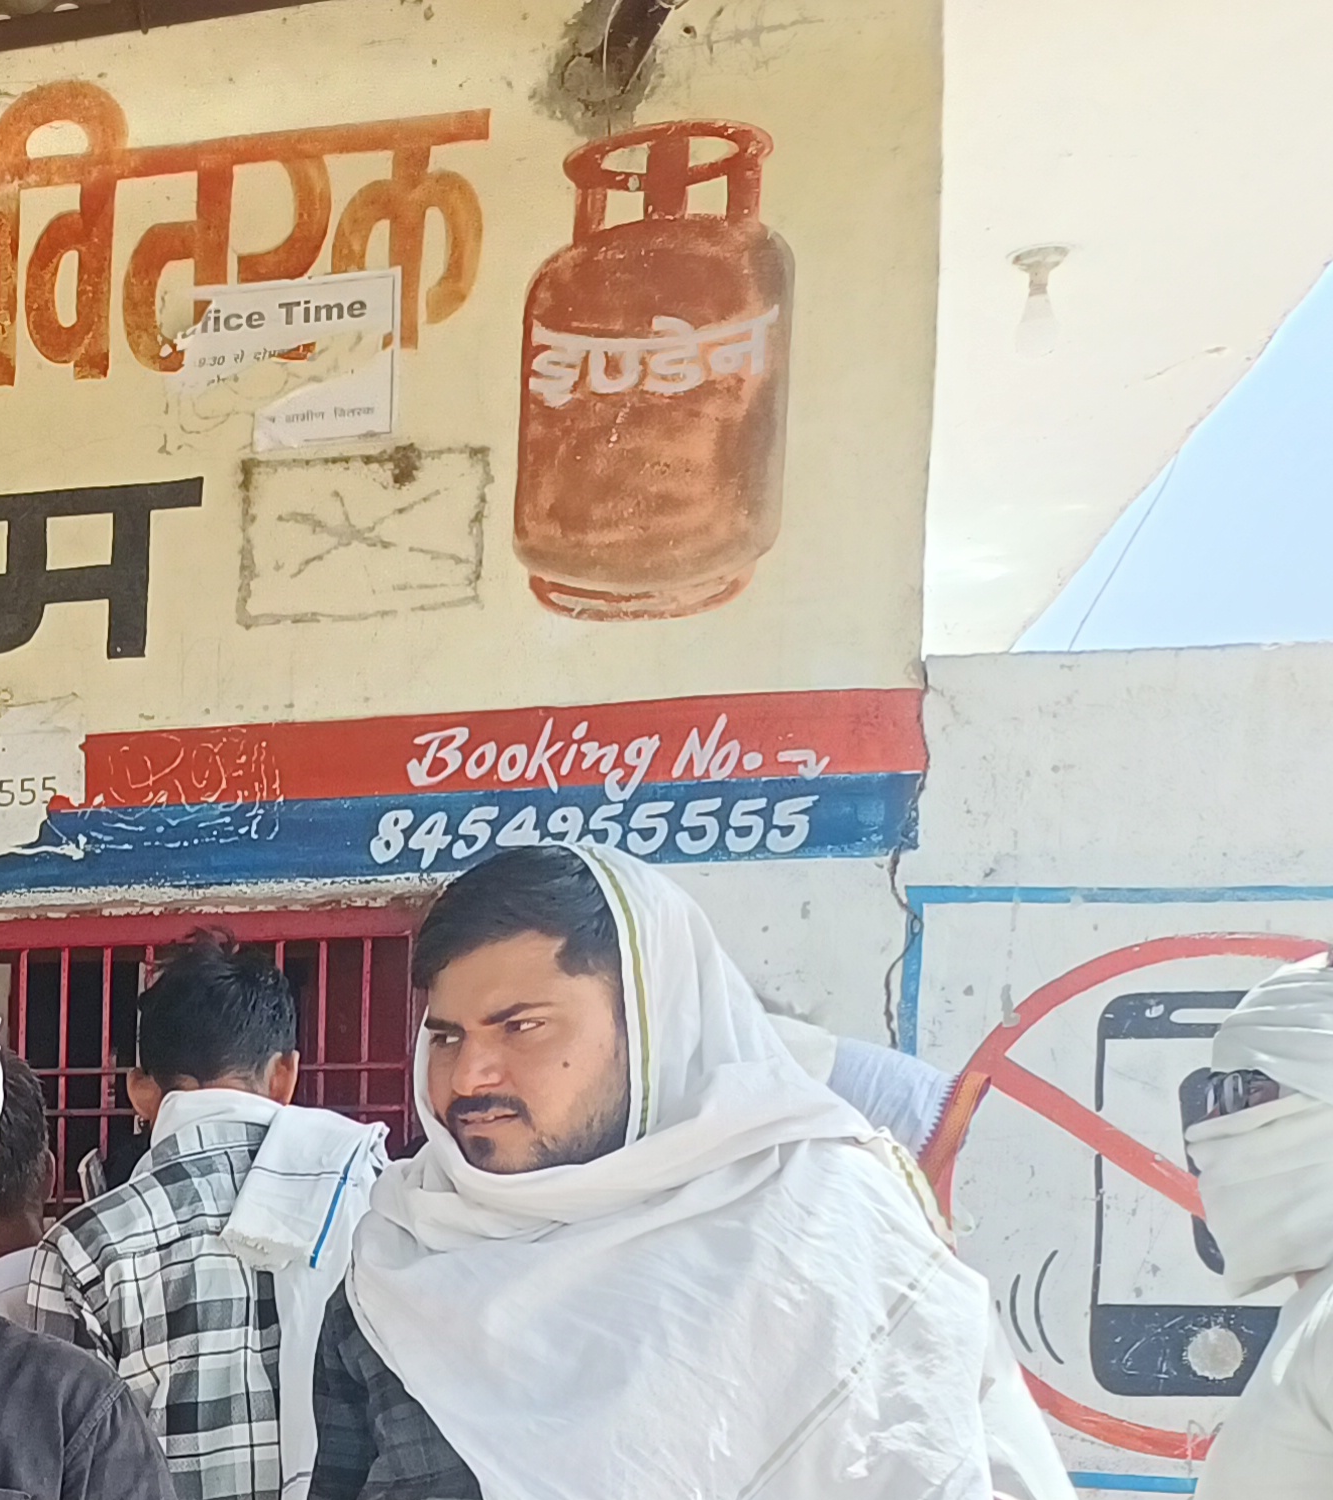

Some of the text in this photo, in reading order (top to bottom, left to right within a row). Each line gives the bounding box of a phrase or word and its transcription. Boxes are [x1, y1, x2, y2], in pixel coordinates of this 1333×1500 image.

[183, 299, 367, 336] fice Time
[528, 304, 780, 409] इण्डेन
[406, 717, 661, 802] Booking
[369, 795, 819, 870] 8454955555
